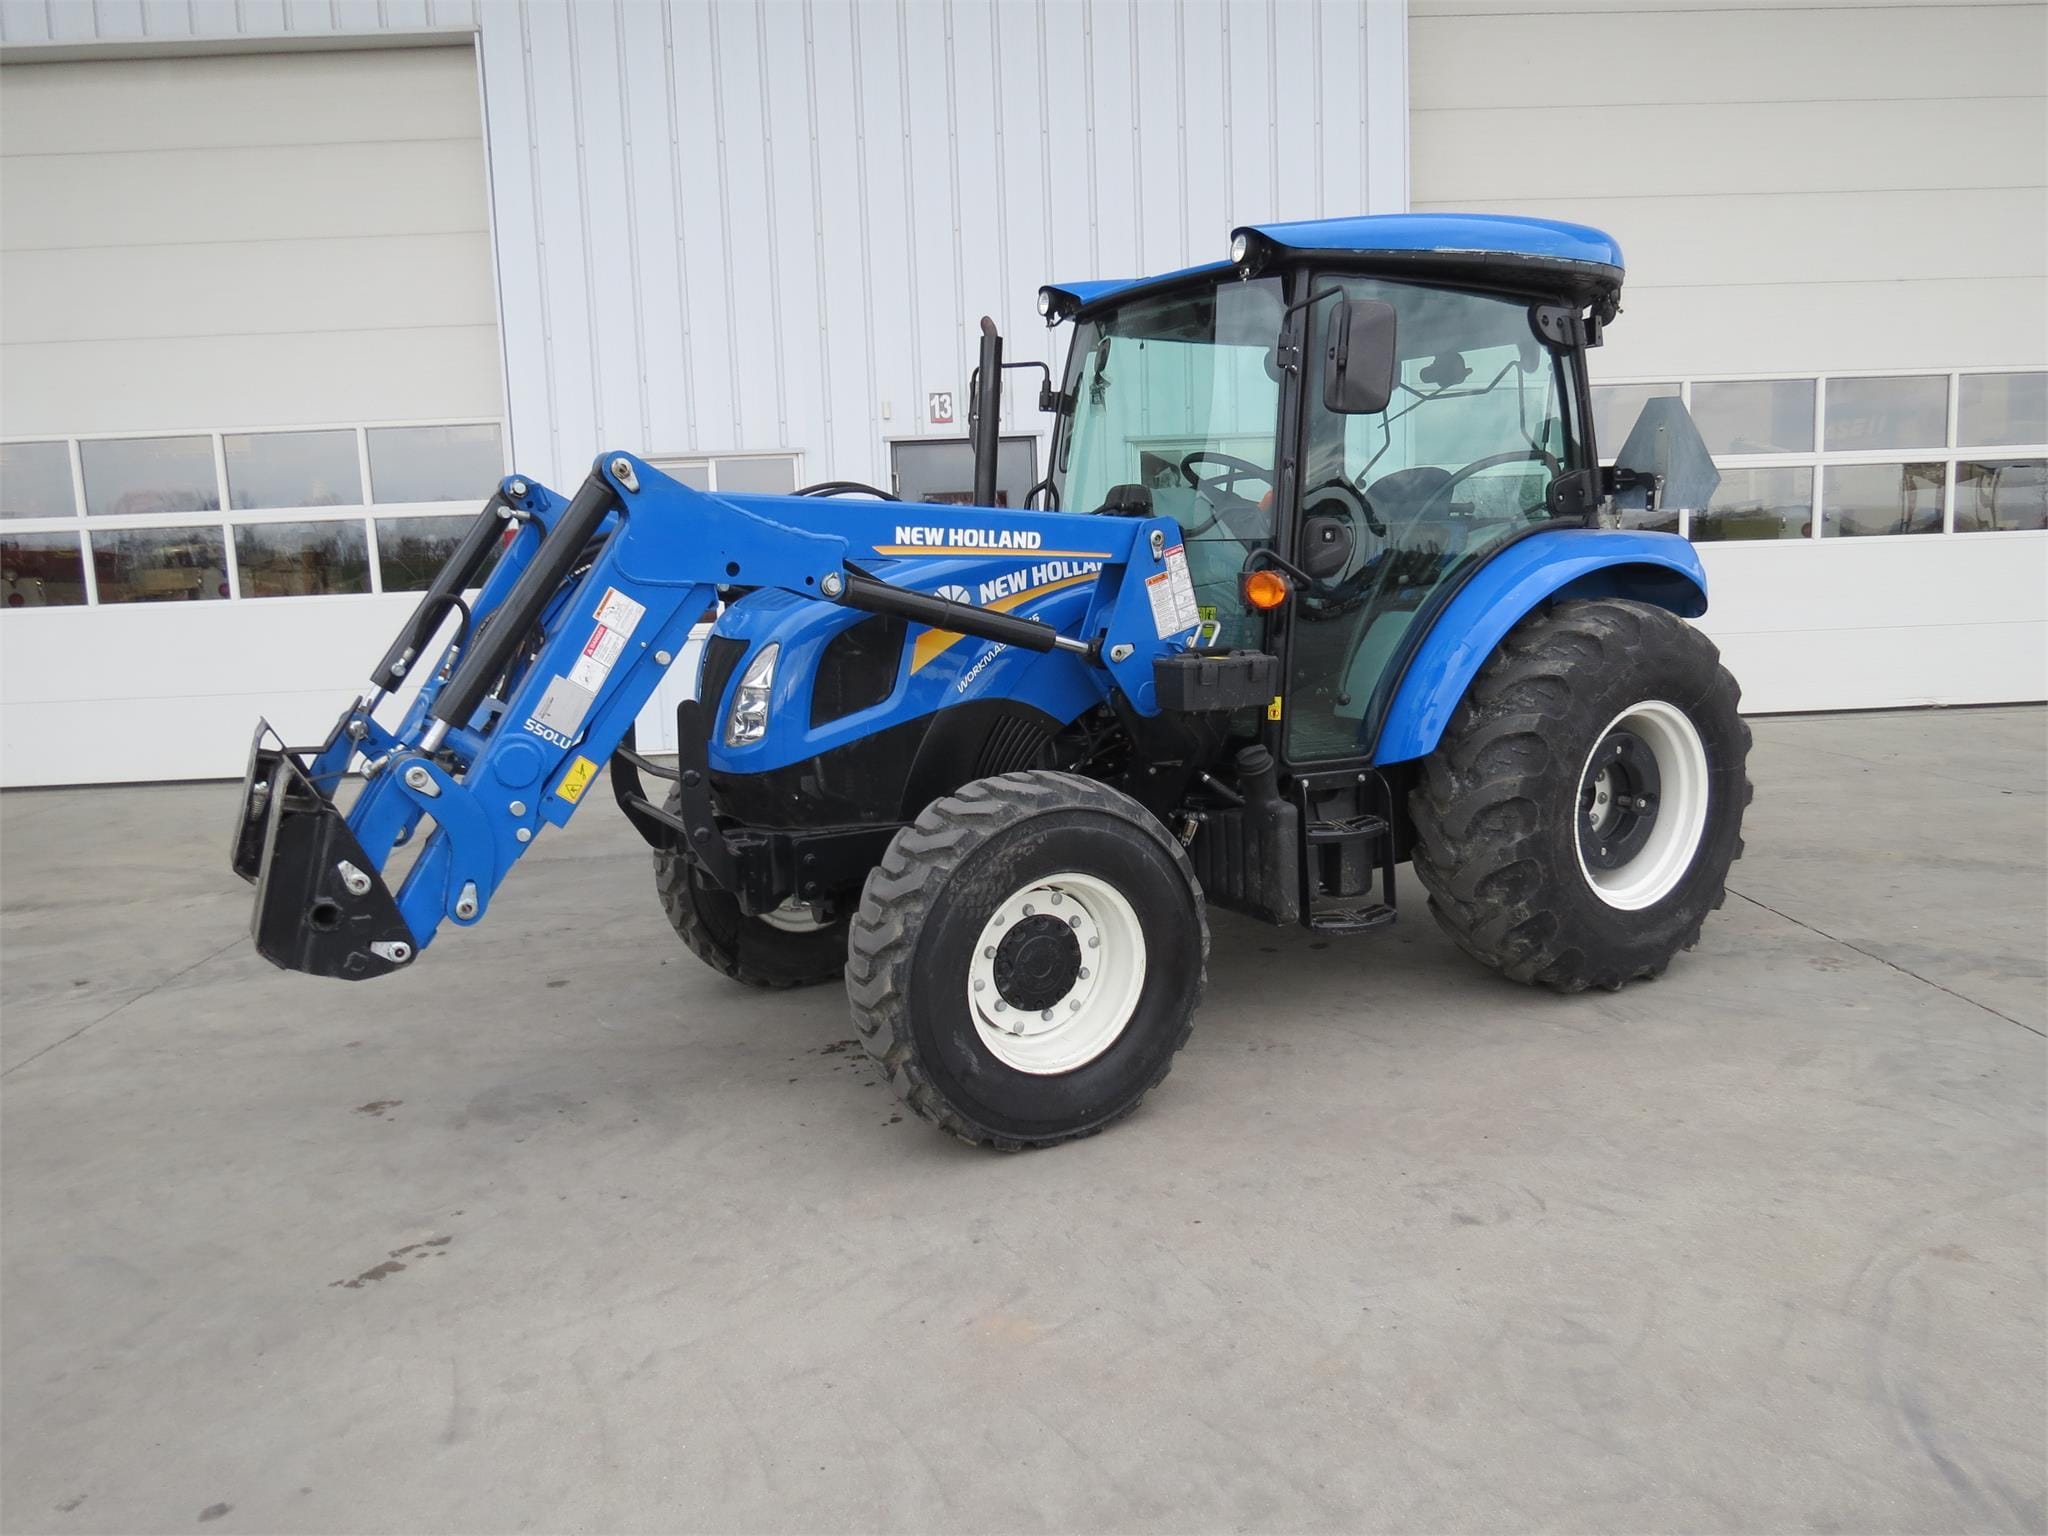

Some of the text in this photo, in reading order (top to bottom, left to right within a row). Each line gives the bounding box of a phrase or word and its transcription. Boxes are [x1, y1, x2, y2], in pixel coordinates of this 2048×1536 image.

[930, 394, 952, 419] 13
[895, 526, 1042, 549] NEW HOLLAND
[979, 569, 1027, 605] NEW
